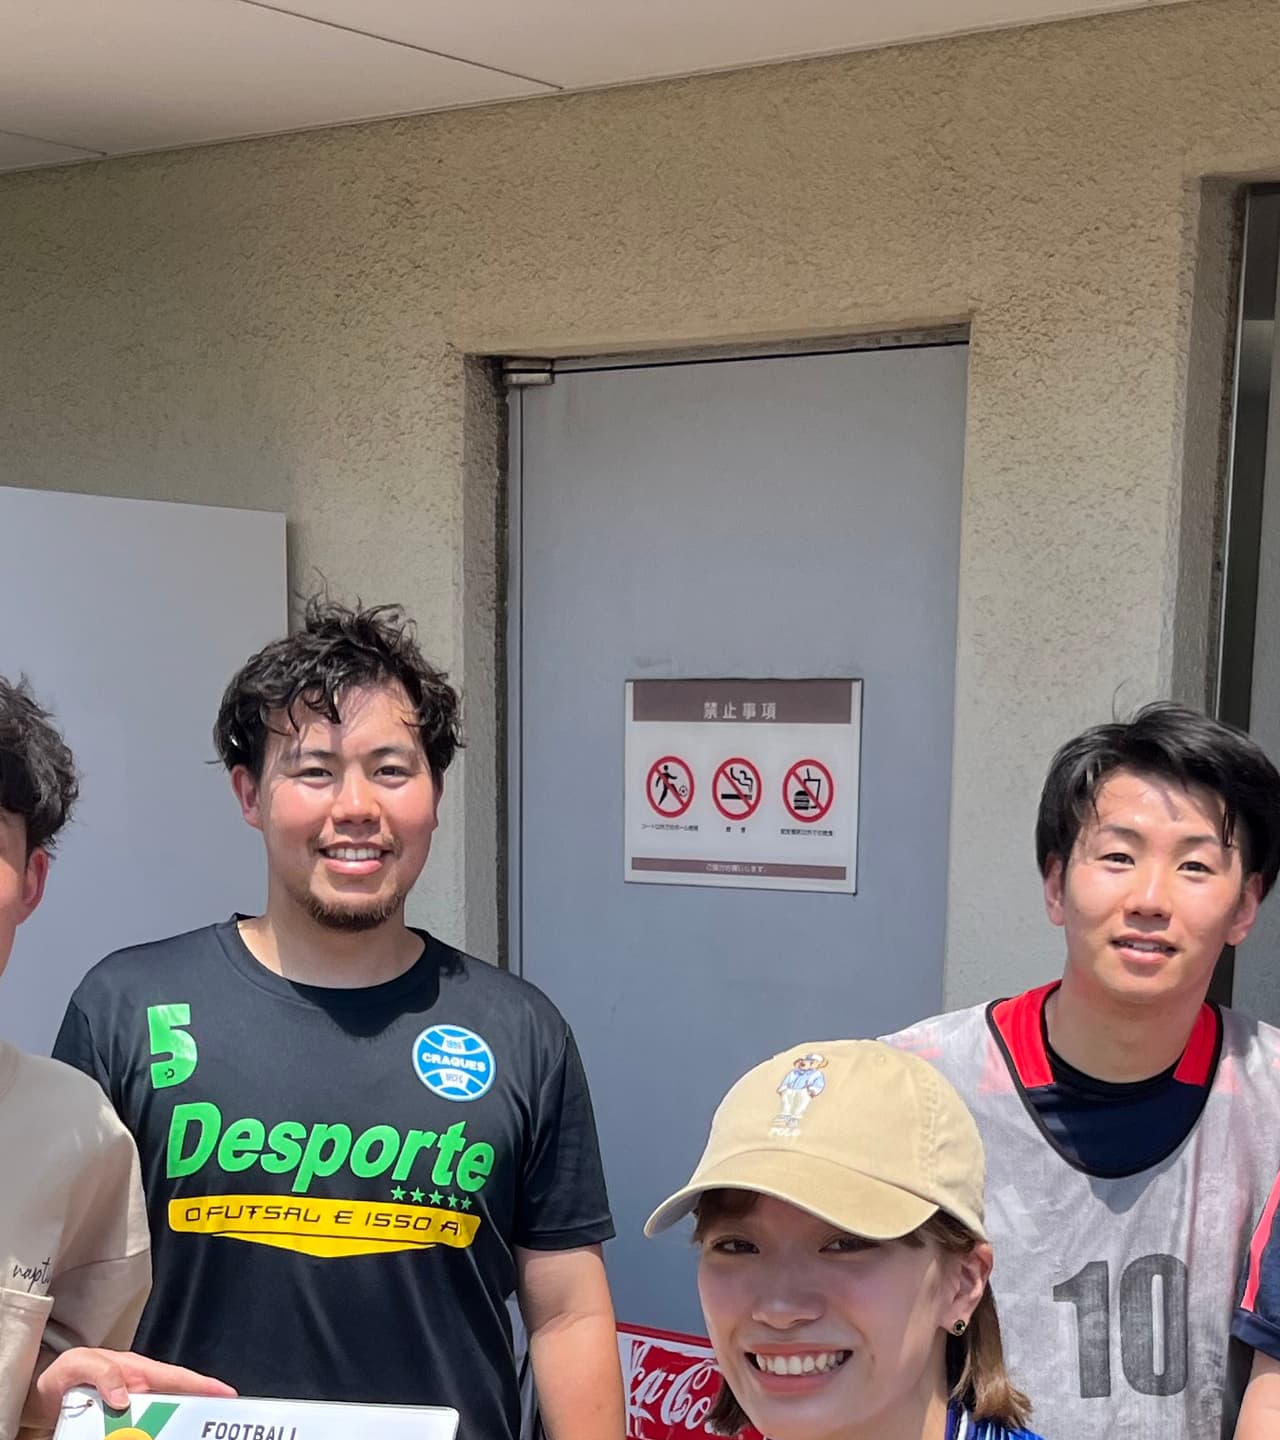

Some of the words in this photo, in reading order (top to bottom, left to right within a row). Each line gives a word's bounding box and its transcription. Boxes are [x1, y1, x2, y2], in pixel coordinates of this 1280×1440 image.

[703, 701, 777, 720] 禁止事項
[147, 1002, 198, 1090] 5
[421, 1051, 487, 1073] CRAQUES
[166, 1101, 496, 1193] Desporte
[365, 1211, 432, 1232] ISSO
[1053, 1253, 1189, 1399] 10
